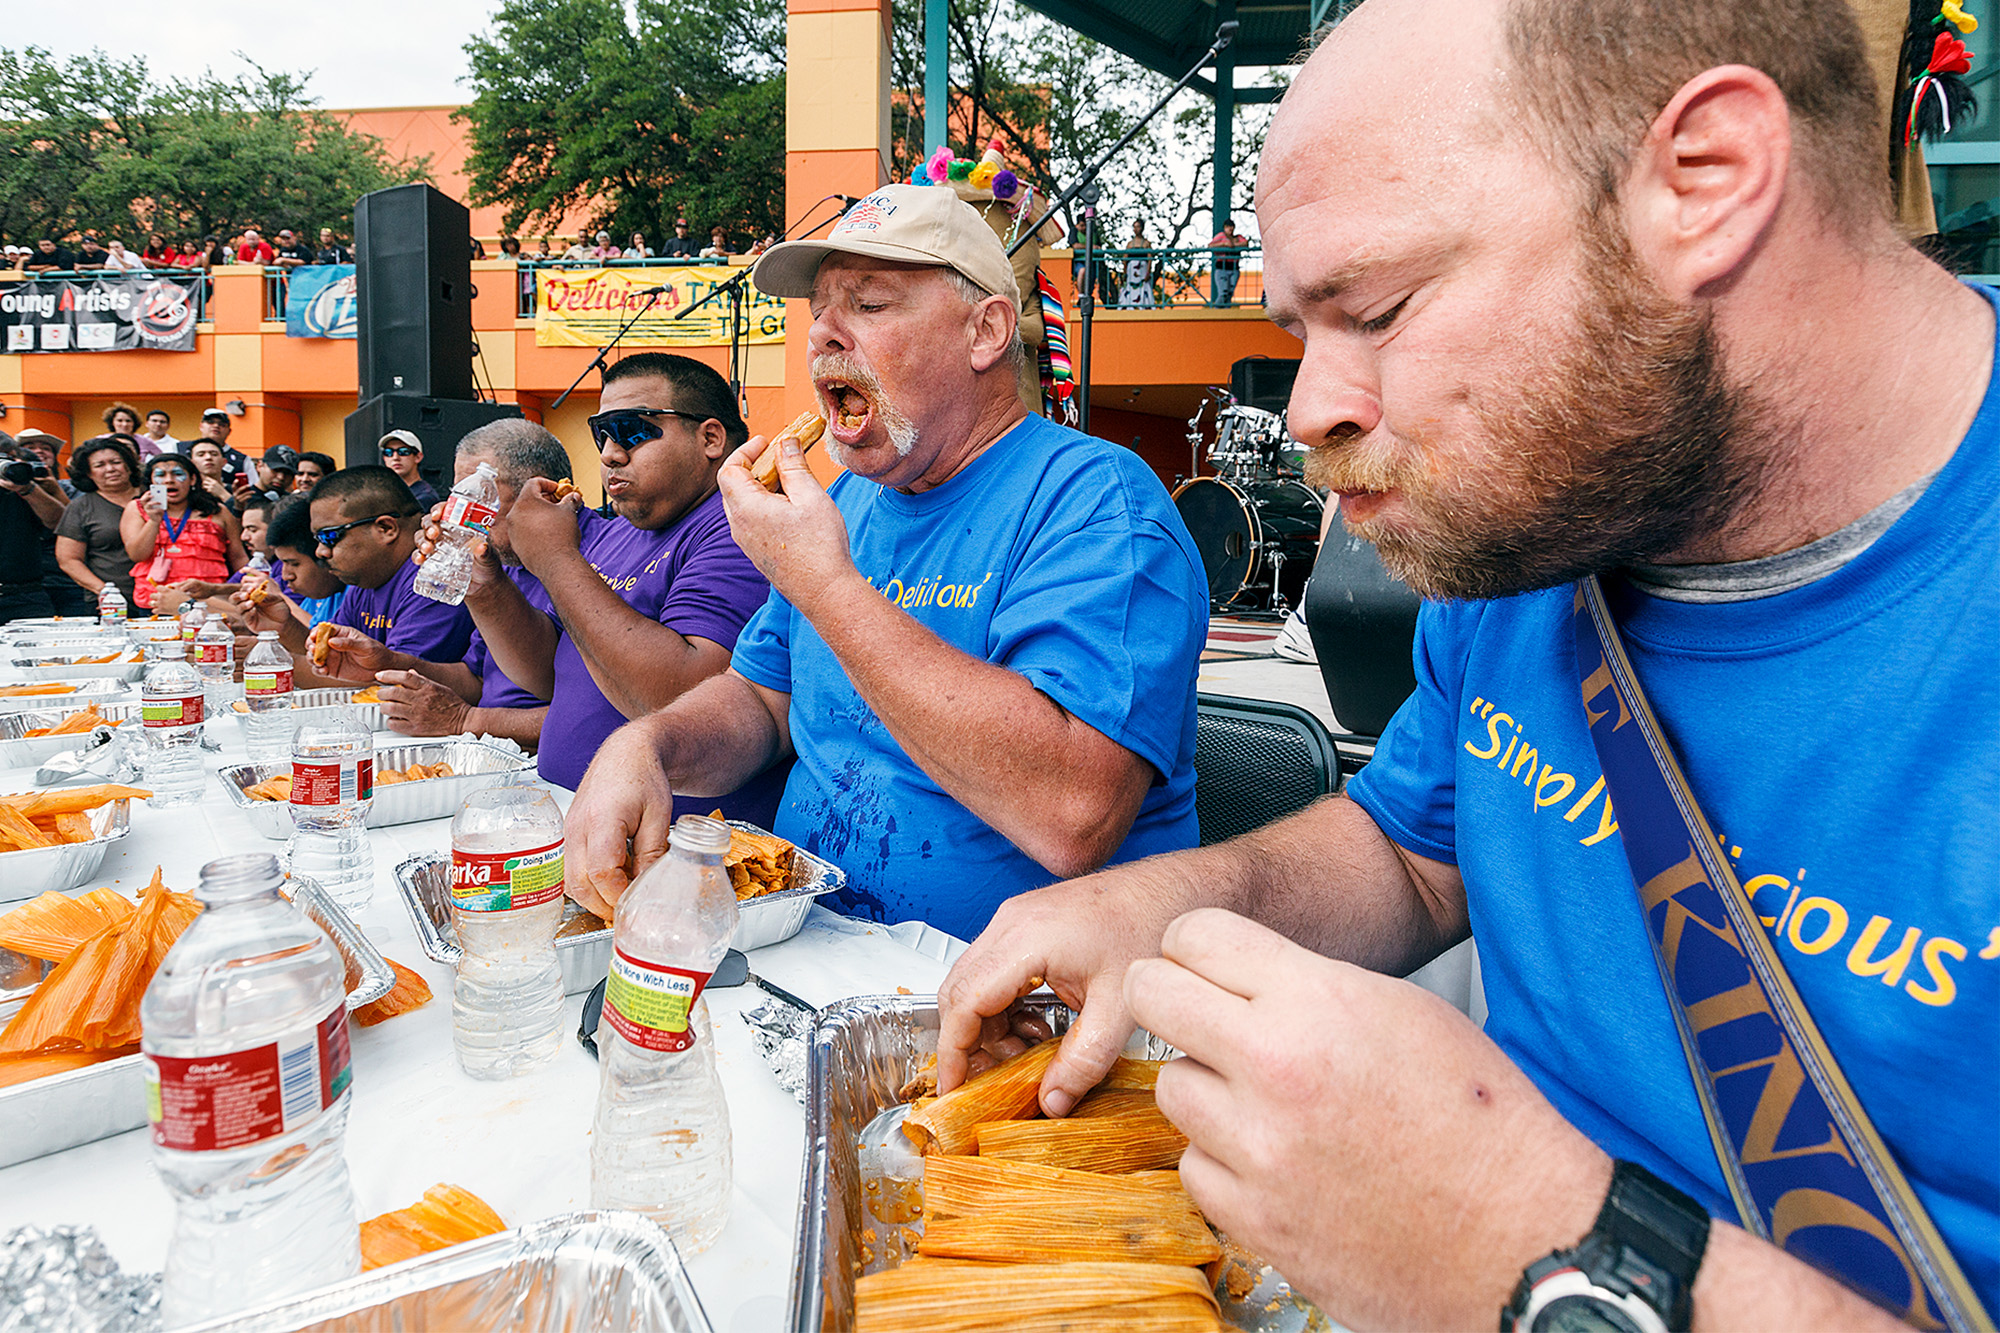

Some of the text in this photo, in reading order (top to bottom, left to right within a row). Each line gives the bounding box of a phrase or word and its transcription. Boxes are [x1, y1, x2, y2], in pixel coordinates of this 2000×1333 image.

[0, 288, 131, 318] oung Artists
[544, 278, 680, 312] Delicious
[446, 862, 491, 886] arka
[522, 856, 543, 866] Doing
[623, 964, 641, 980] More
[643, 972, 665, 987] With
[667, 979, 690, 992] Less
